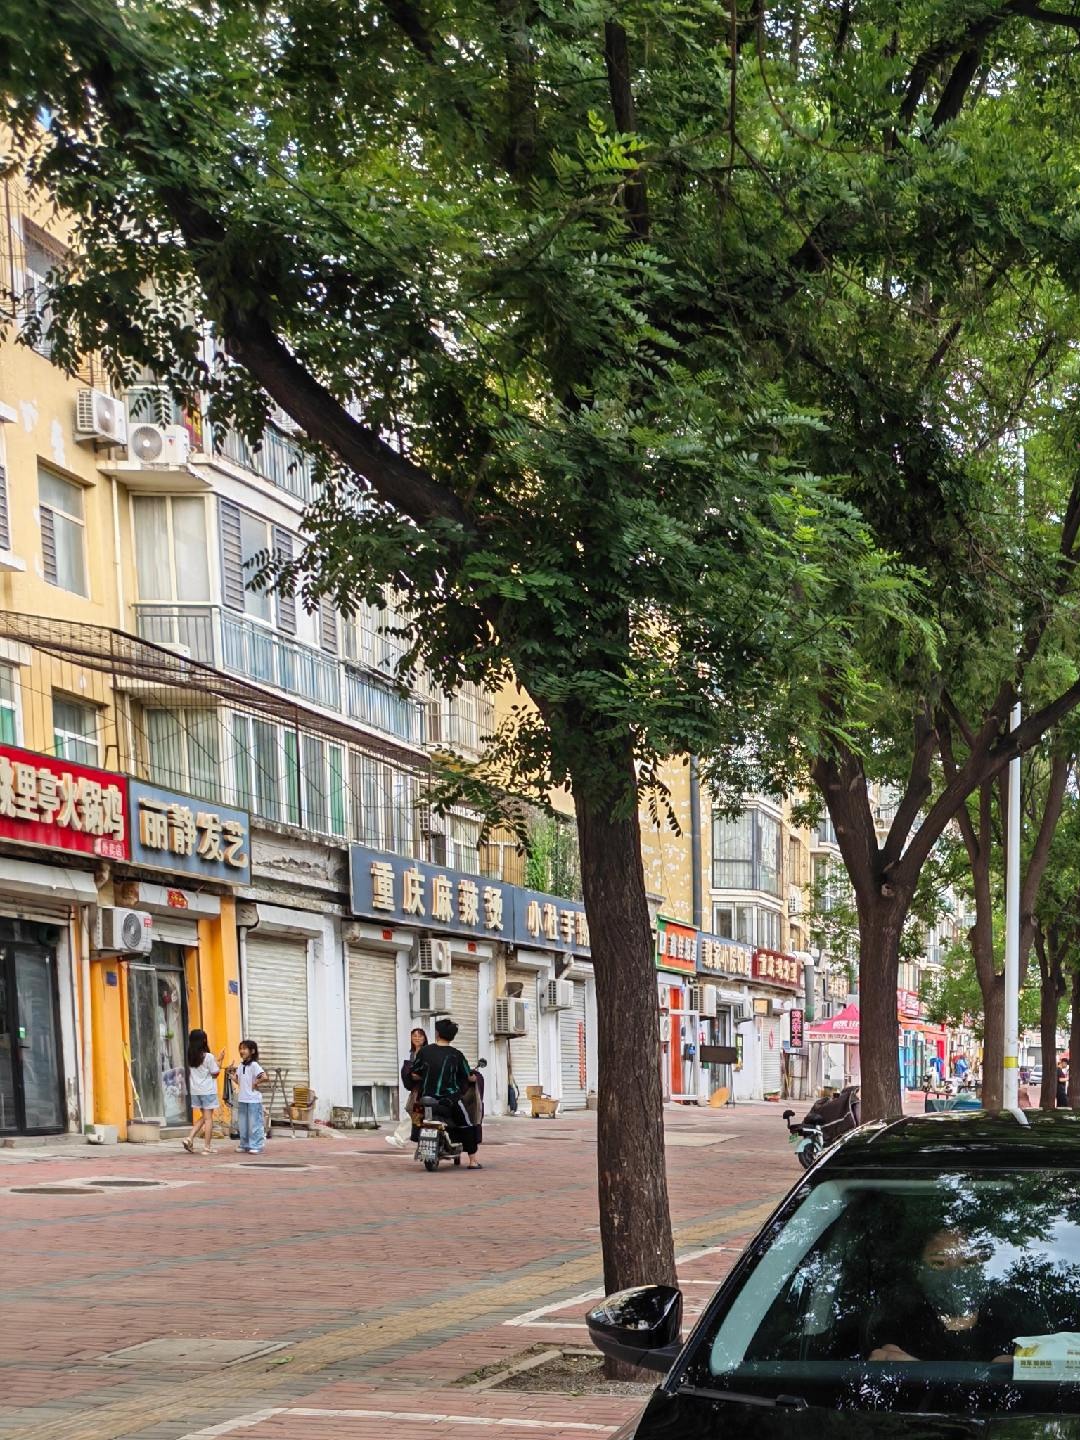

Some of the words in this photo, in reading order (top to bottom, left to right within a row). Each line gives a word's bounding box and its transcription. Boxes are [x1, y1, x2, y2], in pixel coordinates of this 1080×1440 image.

[138, 797, 248, 868] 丽静发艺
[370, 861, 504, 931] 重庆麻辣烫
